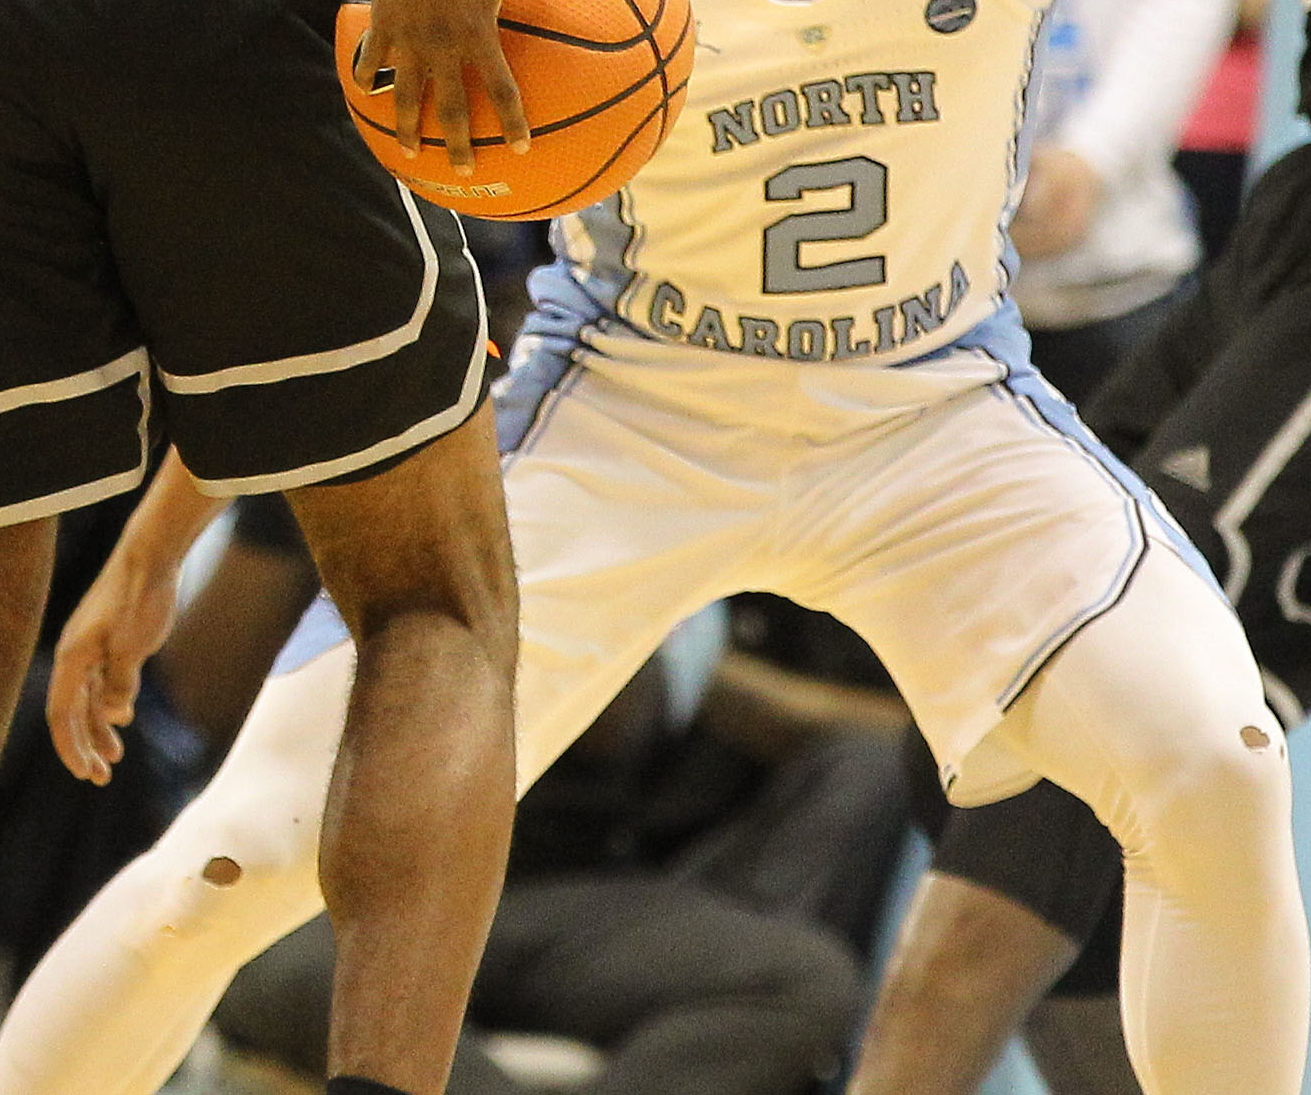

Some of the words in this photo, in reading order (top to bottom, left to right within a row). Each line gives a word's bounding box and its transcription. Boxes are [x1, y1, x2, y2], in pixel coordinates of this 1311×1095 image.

[707, 70, 941, 154] NORTH
[761, 155, 889, 295] 2
[647, 260, 970, 362] CAROLINA
